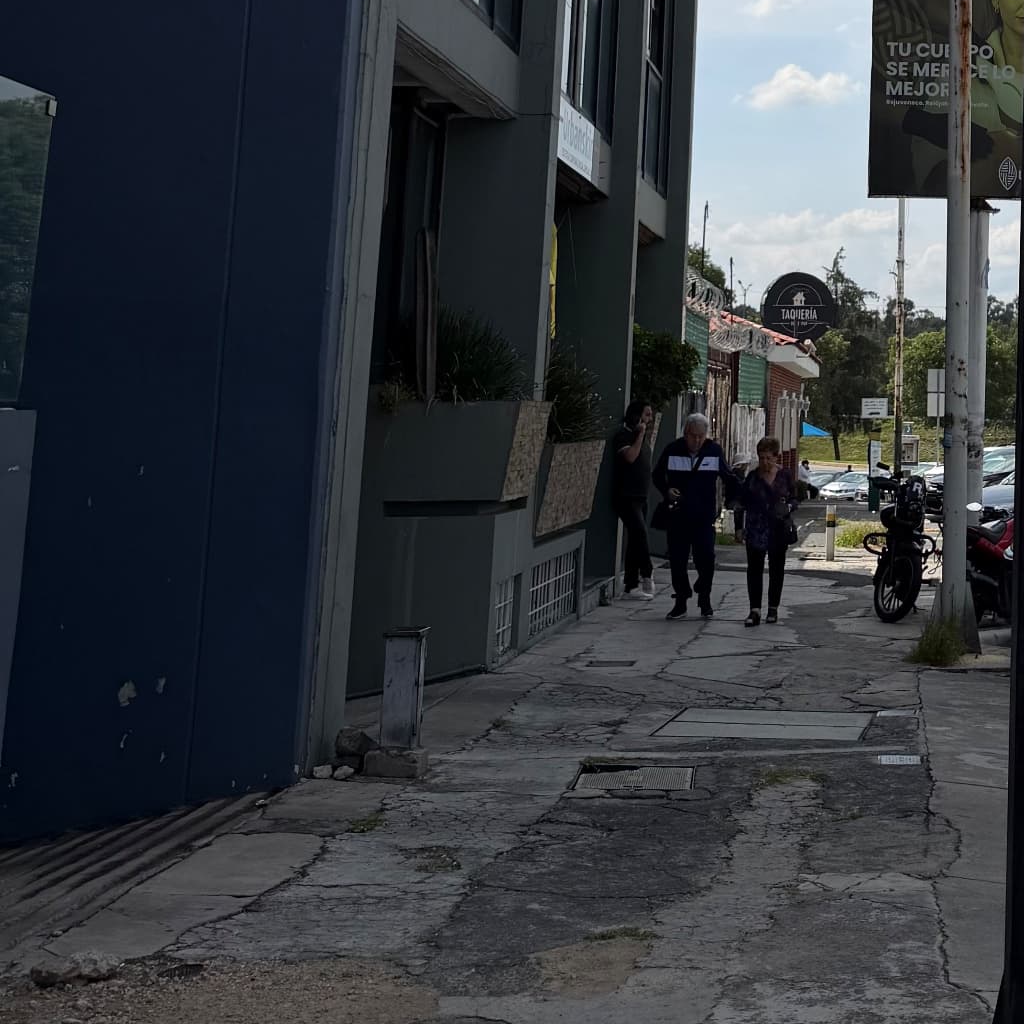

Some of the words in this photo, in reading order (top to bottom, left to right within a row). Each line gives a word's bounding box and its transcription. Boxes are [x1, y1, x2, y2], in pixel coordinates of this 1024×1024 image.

[886, 42, 911, 57] TU
[915, 43, 994, 59] CUEPO
[886, 61, 908, 76] SE
[913, 62, 990, 79] MERCE
[995, 65, 1016, 80] LO
[781, 307, 818, 320] TAQUERÍA
